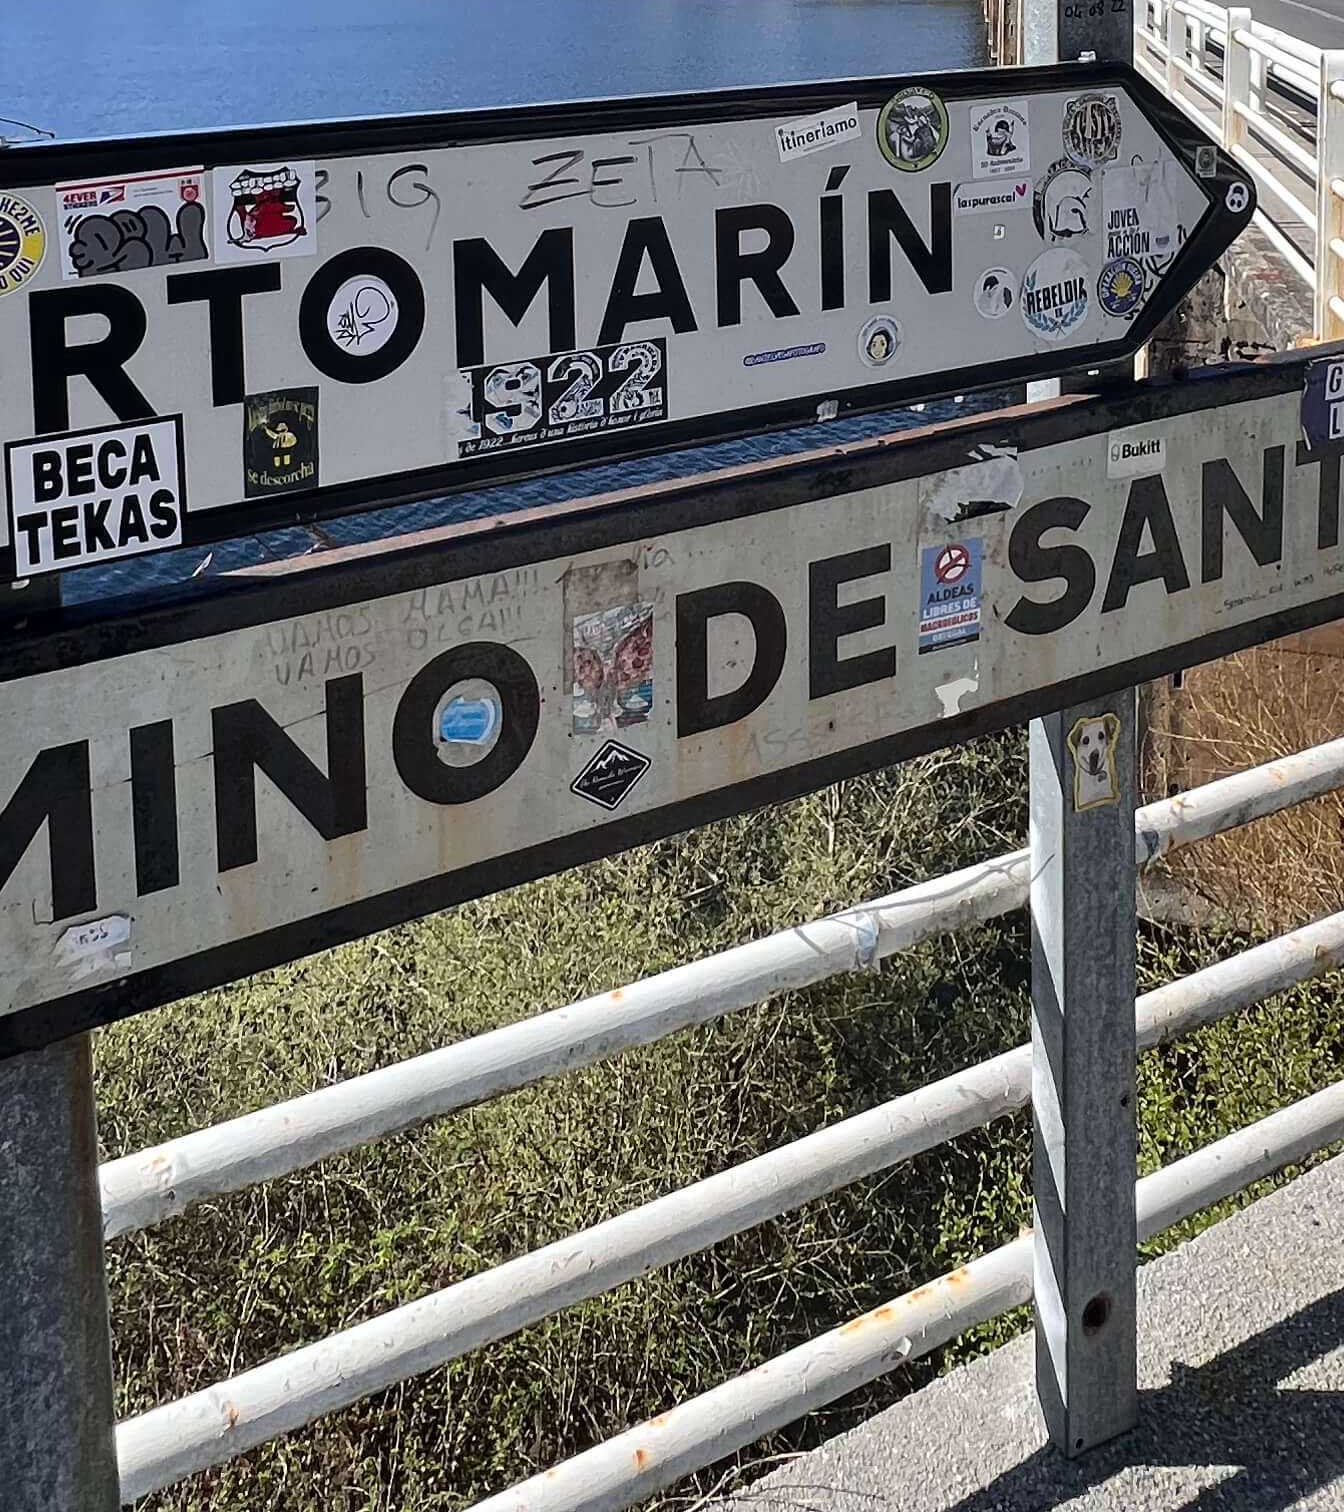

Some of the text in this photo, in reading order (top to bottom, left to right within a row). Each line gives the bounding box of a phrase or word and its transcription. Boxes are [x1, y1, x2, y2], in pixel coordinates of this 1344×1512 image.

[63, 190, 98, 204] 4EVER
[11, 257, 36, 283] QUI
[1122, 439, 1160, 459] Bukitt
[31, 433, 161, 504] BECA
[17, 488, 178, 565] TEKAS
[927, 583, 975, 605] ALDEAS
[922, 596, 977, 620] LIBRES DE
[675, 542, 897, 740] DE
